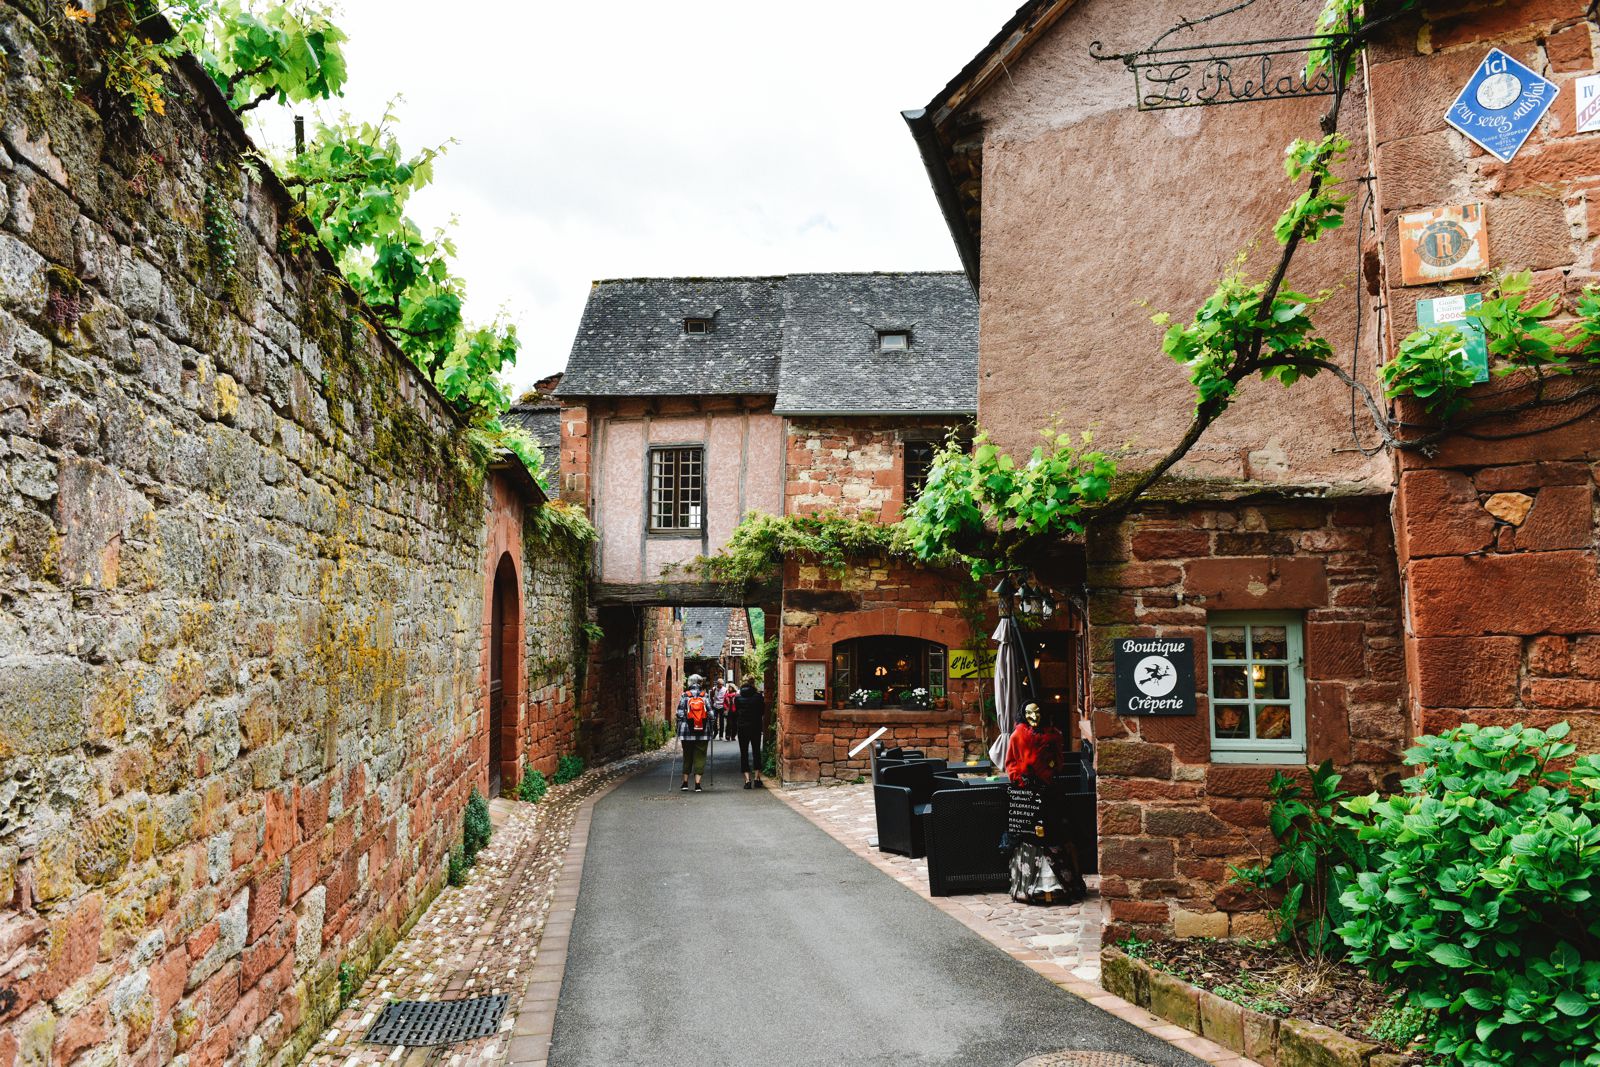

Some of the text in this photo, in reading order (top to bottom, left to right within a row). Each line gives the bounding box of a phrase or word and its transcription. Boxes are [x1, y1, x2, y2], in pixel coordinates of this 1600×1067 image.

[1484, 56, 1507, 76] ici
[1144, 55, 1330, 106] Le Relais
[1584, 85, 1594, 98] IV
[1454, 81, 1546, 133] vous serez satisfait
[1435, 232, 1454, 258] R
[1440, 312, 1461, 321] 2006
[1122, 639, 1185, 656] Boutique
[1128, 695, 1183, 713] Crêperie
